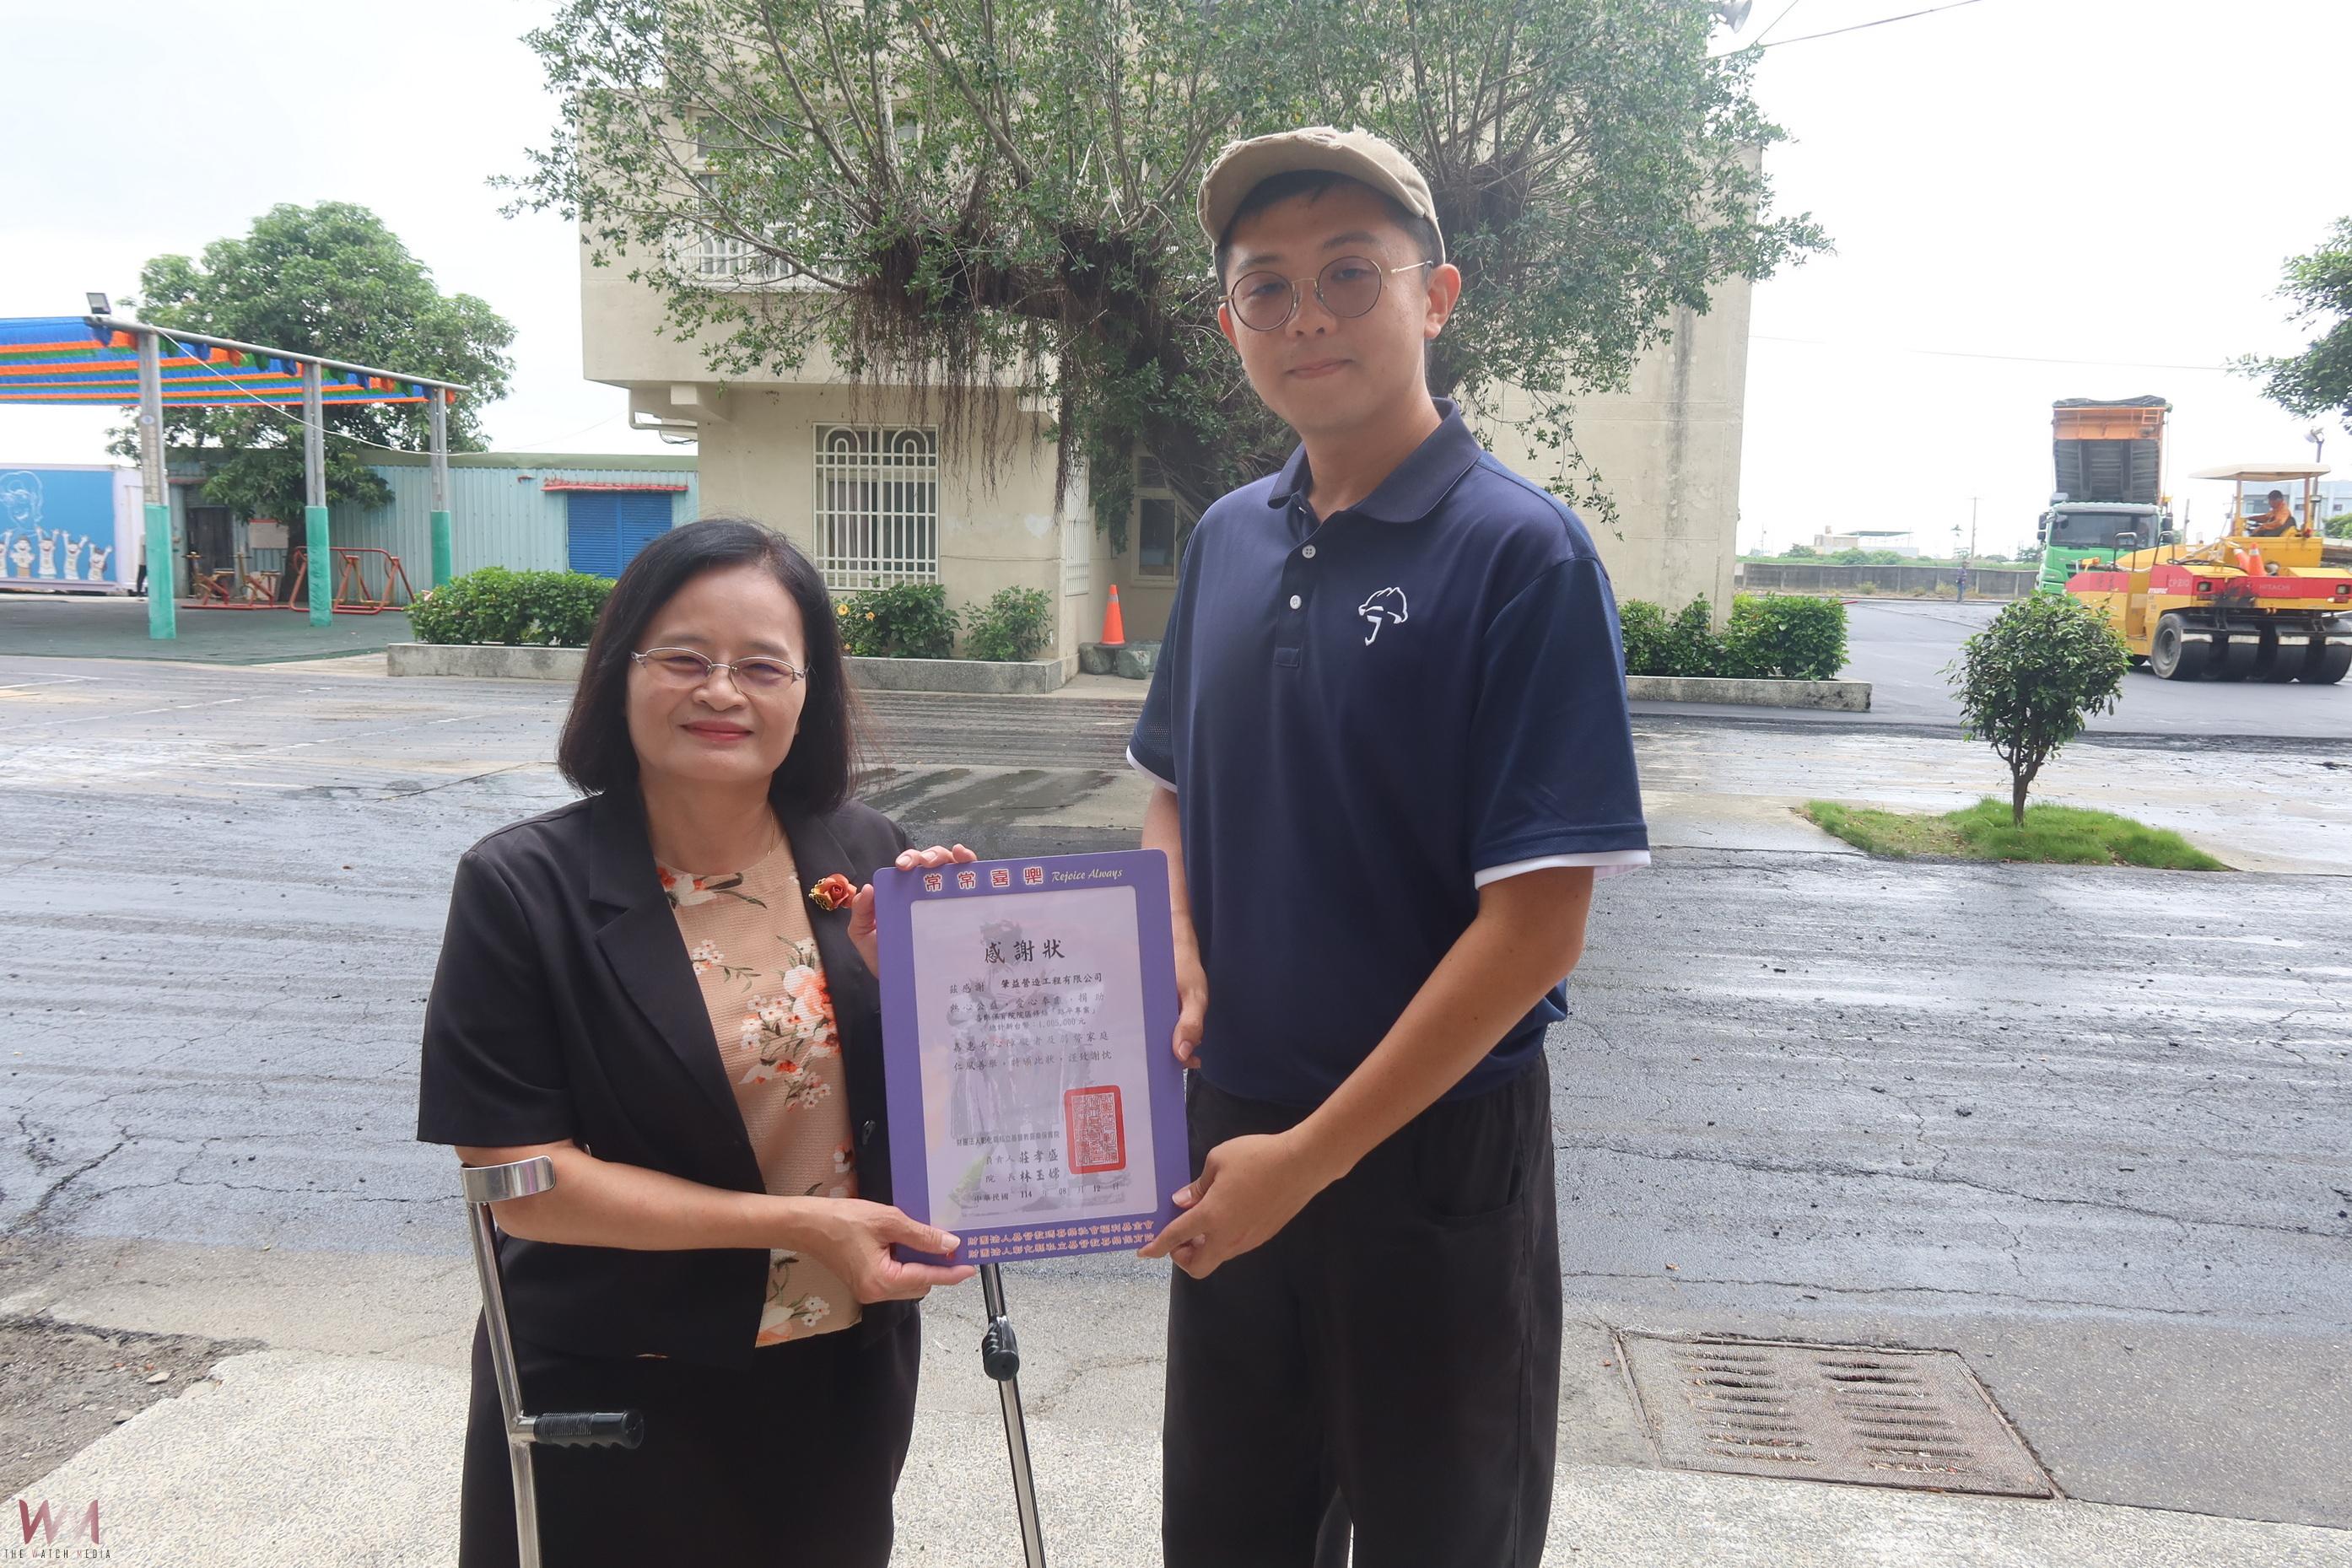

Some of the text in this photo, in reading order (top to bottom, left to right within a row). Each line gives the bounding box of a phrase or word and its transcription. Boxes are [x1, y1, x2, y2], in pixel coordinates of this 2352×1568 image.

[924, 867, 1124, 892] 常常喜樂 Rejoice Always
[984, 939, 1065, 964] 感謝狀
